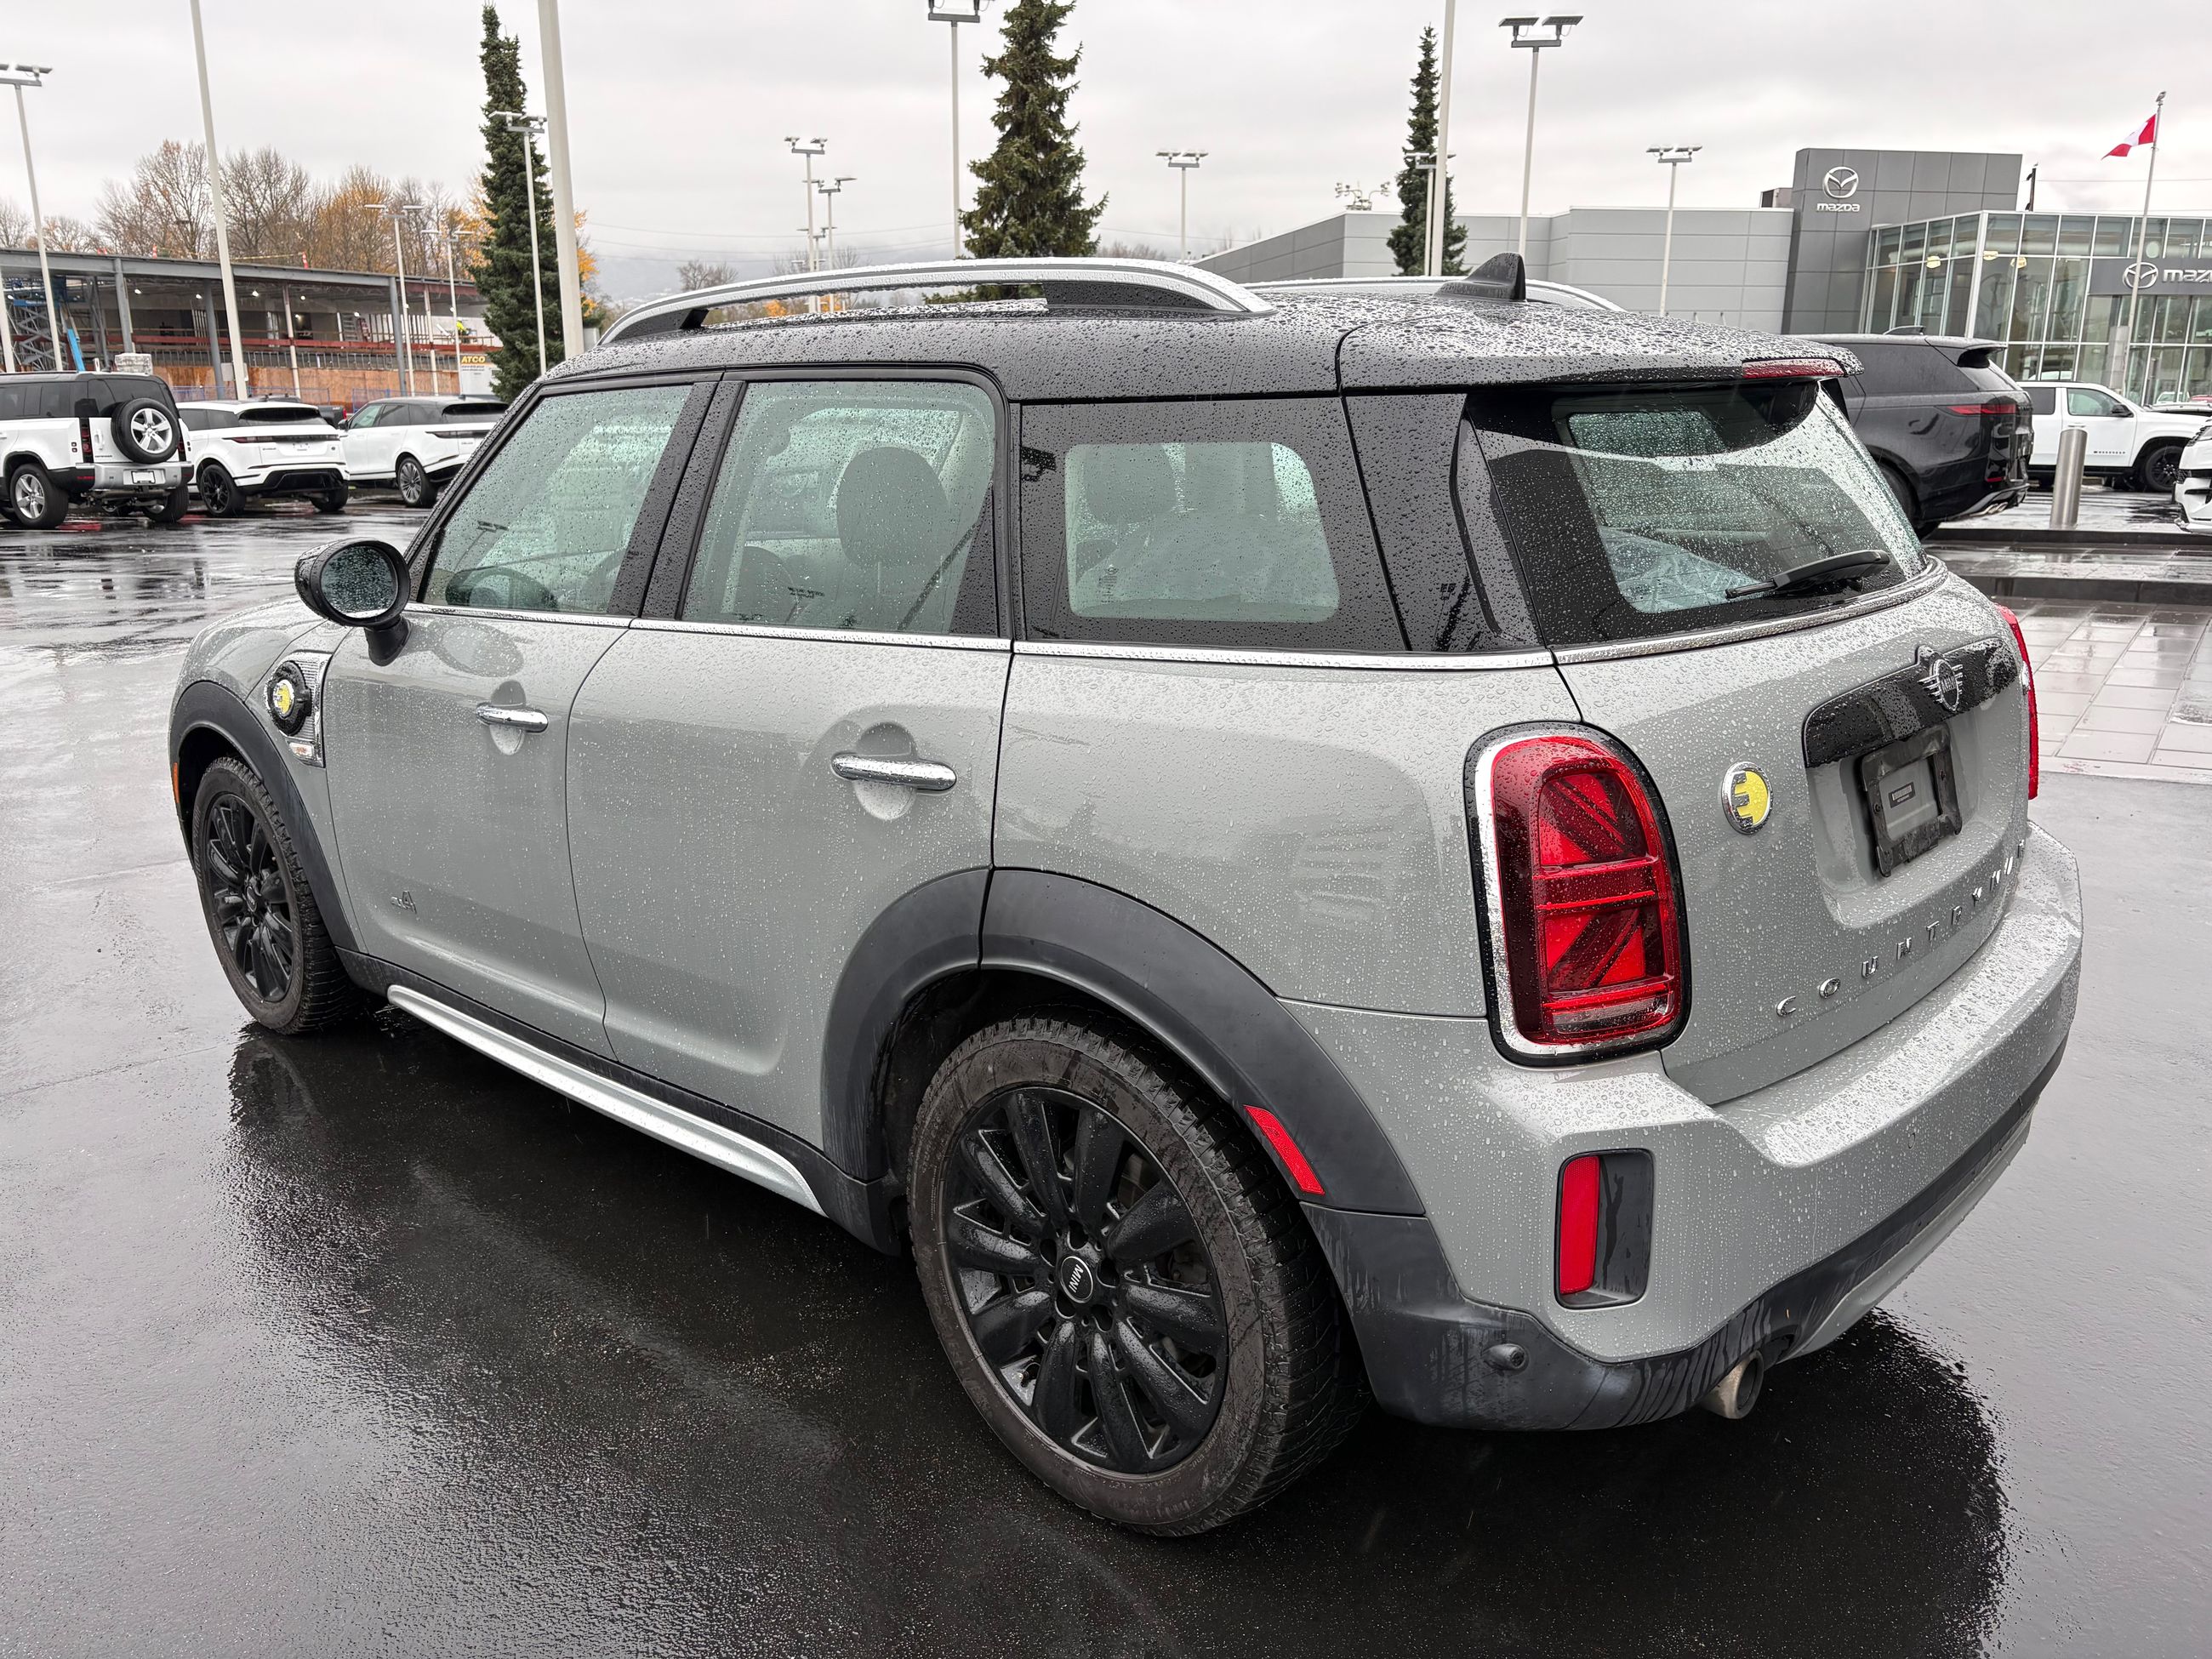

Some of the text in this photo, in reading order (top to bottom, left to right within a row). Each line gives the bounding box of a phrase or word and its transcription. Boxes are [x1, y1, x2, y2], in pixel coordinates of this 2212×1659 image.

[2163, 269, 2212, 283] maz
[461, 356, 486, 364] ATCO
[1069, 1263, 1084, 1293] MINI
